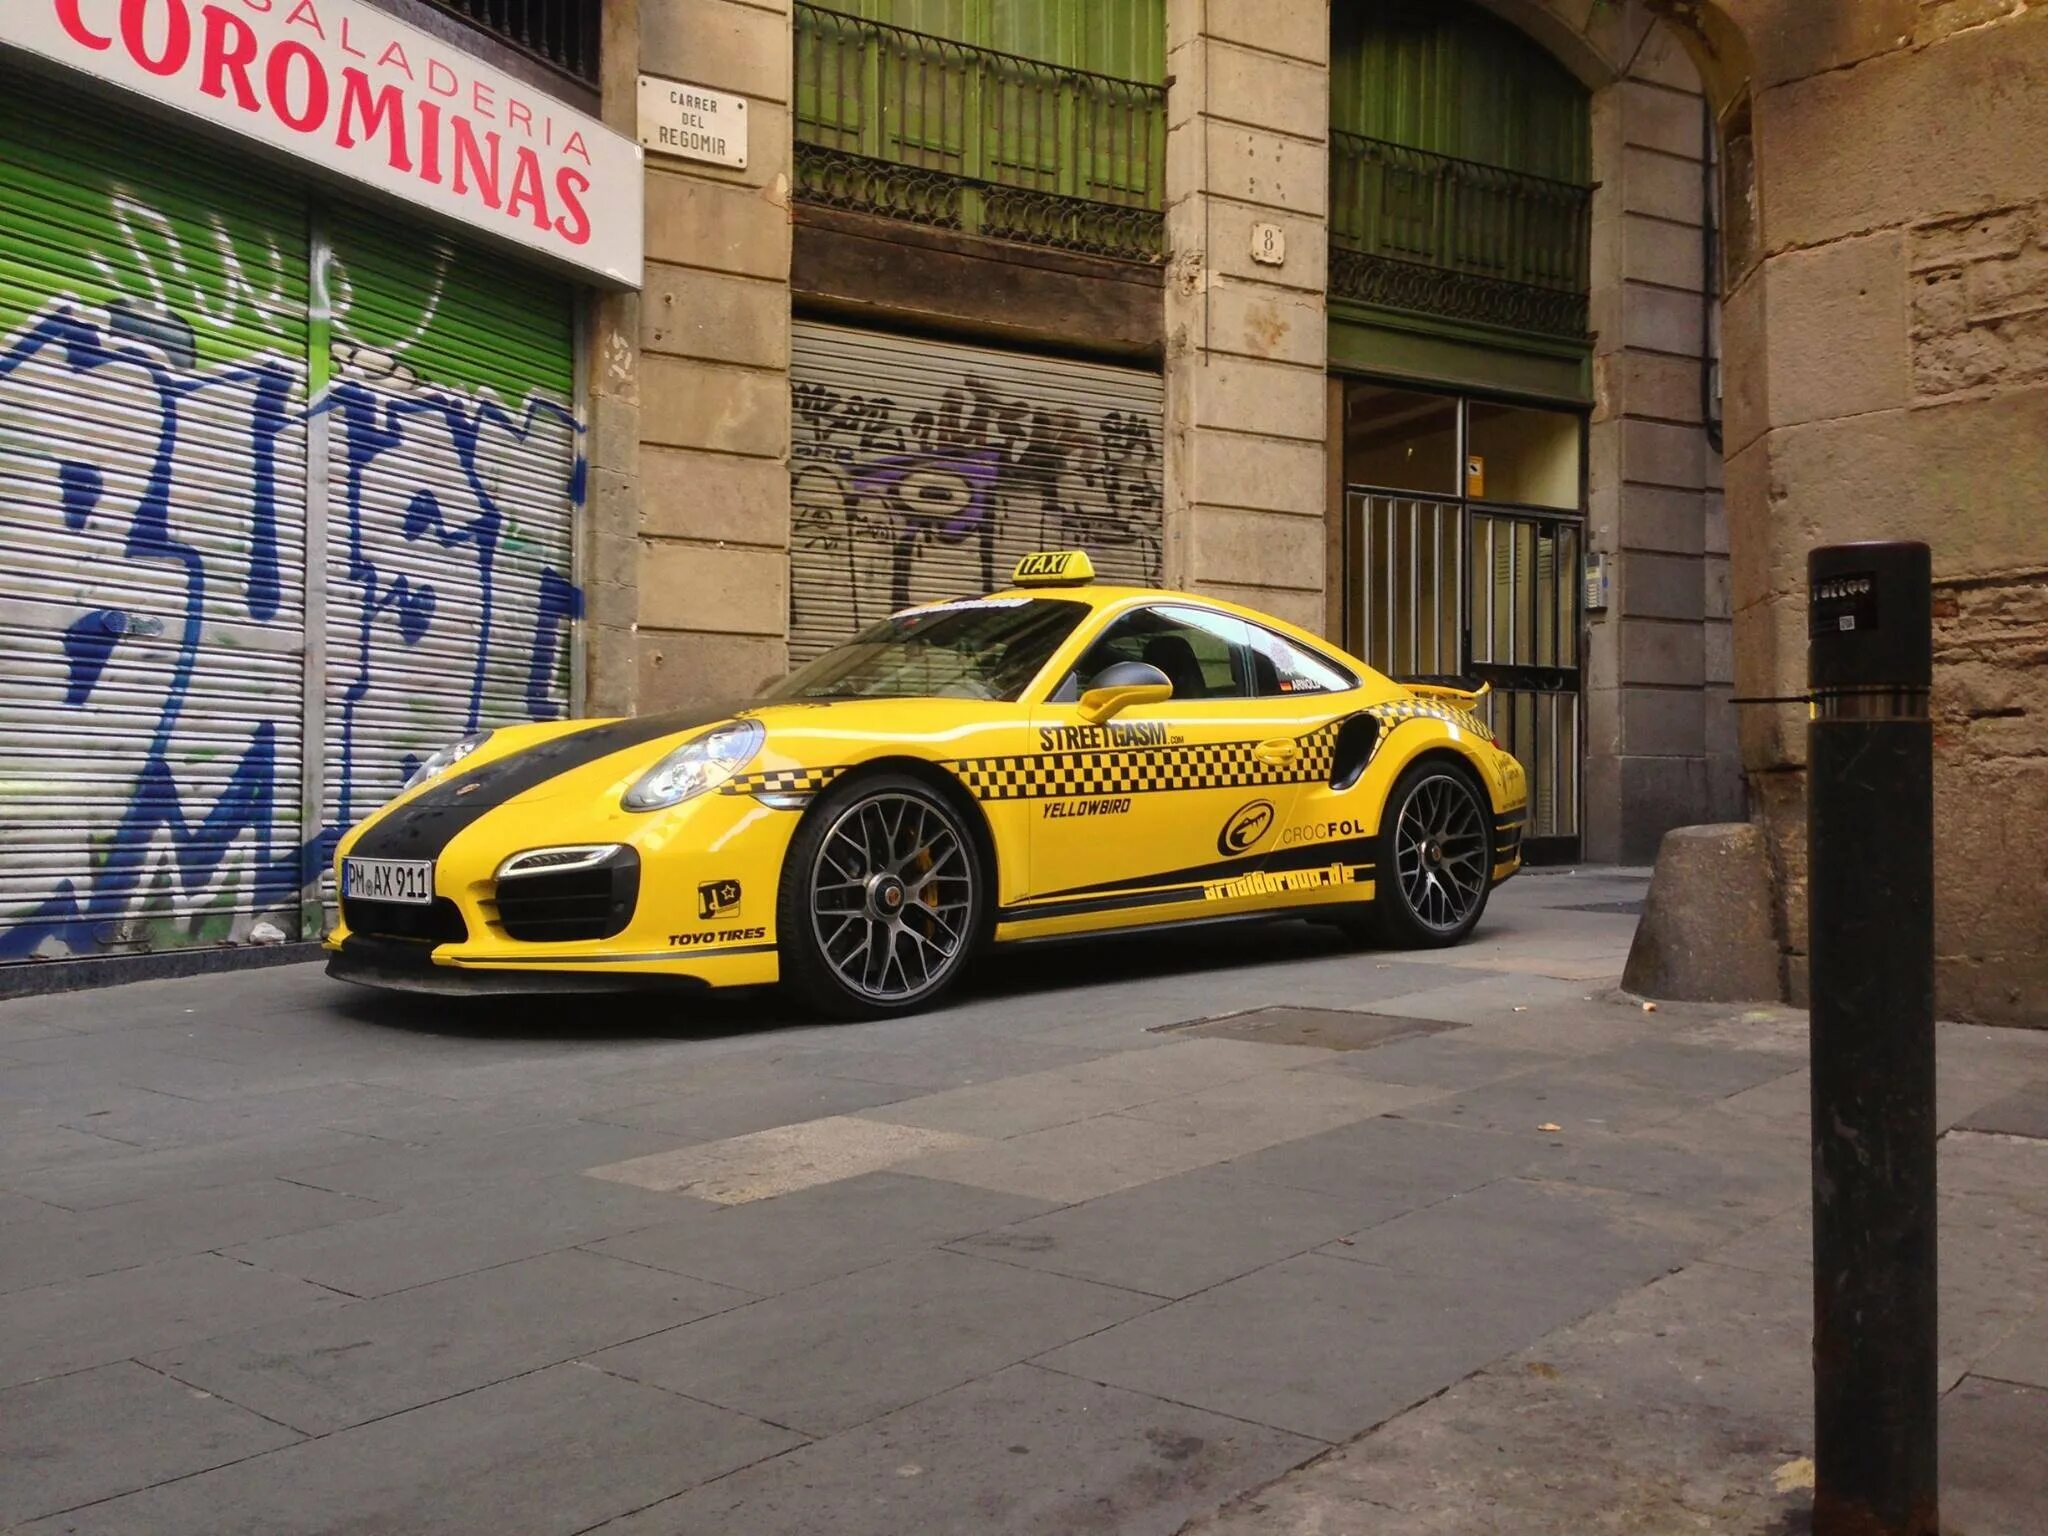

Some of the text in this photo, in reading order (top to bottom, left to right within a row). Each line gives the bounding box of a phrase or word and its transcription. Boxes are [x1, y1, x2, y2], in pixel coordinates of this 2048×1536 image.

[243, 0, 592, 166] ALADERIA
[670, 91, 717, 113] CARRER
[681, 112, 704, 129] DEL
[659, 125, 726, 156] REGOMIR
[1264, 229, 1274, 251] 8
[1022, 554, 1069, 575] TAXI
[1043, 798, 1131, 818] YELLOWBIRD
[1282, 819, 1364, 844] CROCFOL
[348, 863, 427, 897] PM AX 911
[668, 927, 766, 946] TOYO TIRES
